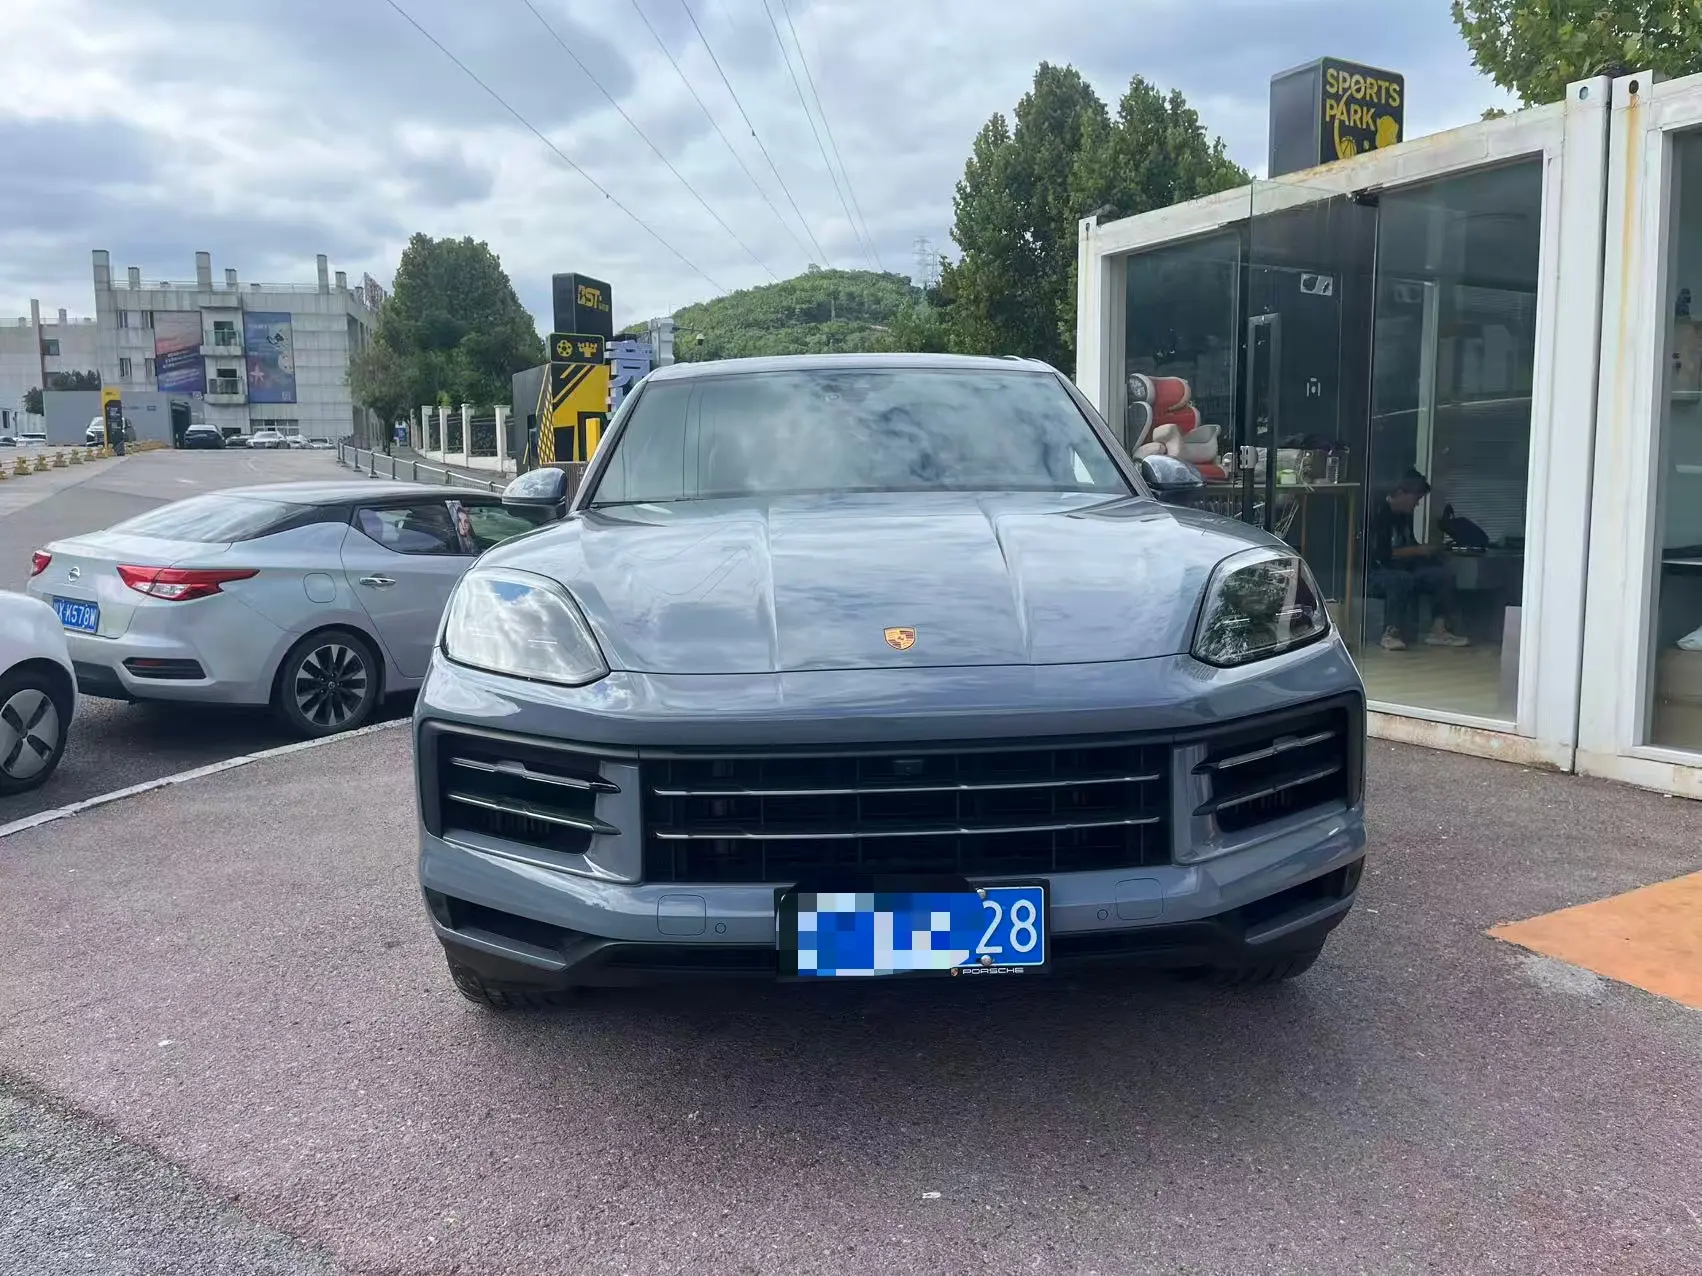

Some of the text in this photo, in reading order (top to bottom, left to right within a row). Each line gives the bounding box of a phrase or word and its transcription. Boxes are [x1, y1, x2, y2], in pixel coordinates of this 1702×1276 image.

[1325, 68, 1400, 107] SPORTS
[1325, 98, 1376, 131] PARK
[962, 967, 1025, 975] PORSCHE
